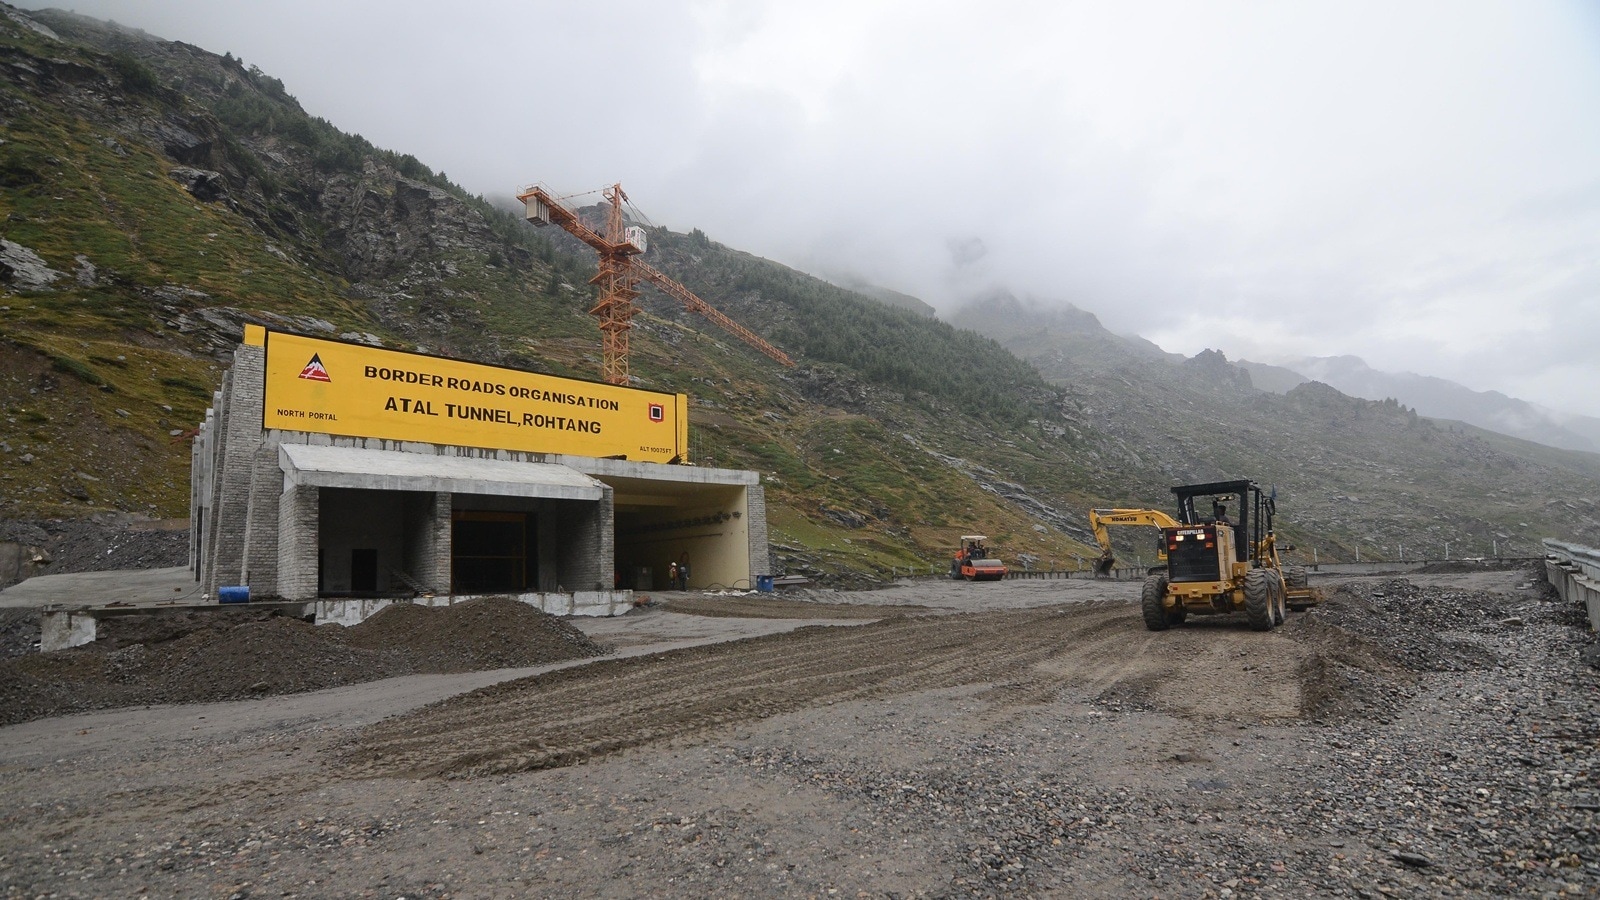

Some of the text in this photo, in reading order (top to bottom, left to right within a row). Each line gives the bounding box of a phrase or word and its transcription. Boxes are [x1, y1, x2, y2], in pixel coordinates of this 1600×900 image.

[364, 365, 619, 412] BORDER ROADS ORGANISATION
[277, 408, 338, 421] NORTH PORTAL
[384, 396, 439, 416] ATAL
